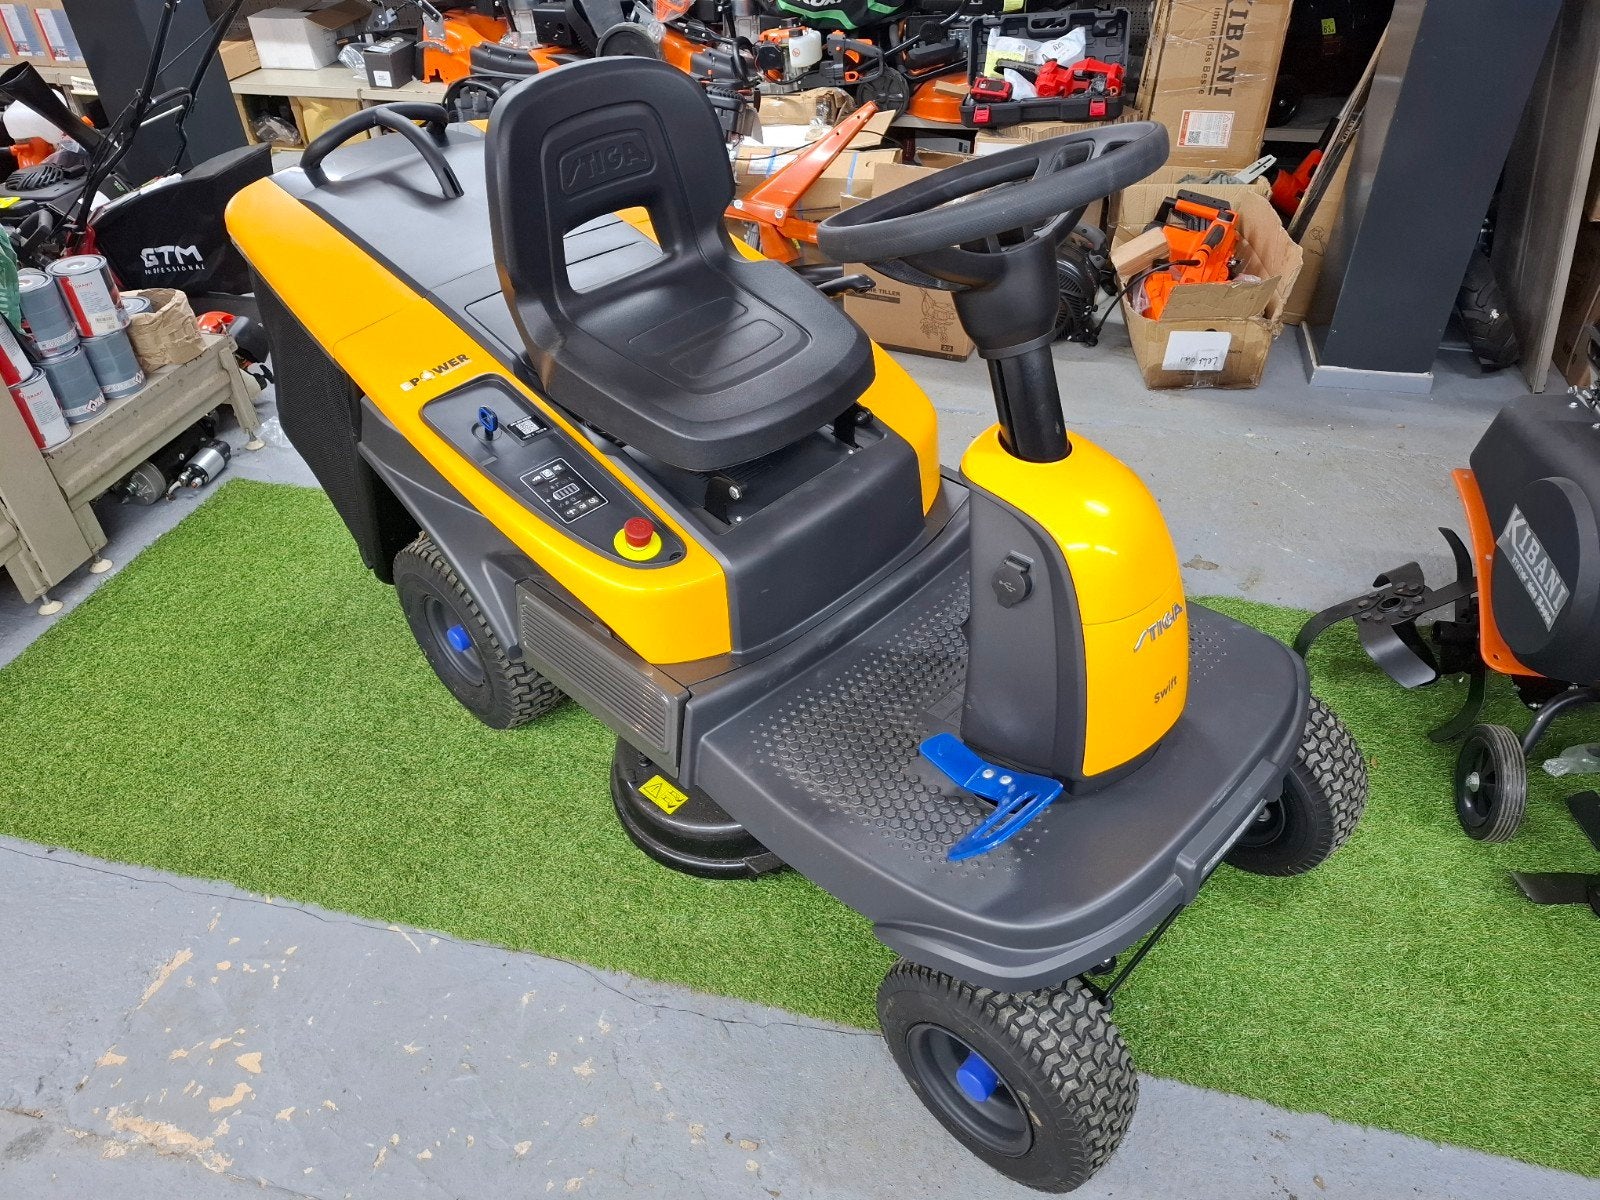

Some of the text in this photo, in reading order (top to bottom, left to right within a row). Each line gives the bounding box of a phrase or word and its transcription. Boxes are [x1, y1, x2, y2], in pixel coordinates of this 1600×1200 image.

[1214, 0, 1252, 97] IBANI
[568, 141, 647, 187] STIGA
[140, 245, 203, 268] GTM
[879, 288, 901, 297] TILLER
[1504, 507, 1567, 610] KIBANI
[1133, 602, 1183, 653] STIGA
[1153, 676, 1177, 703] Swift
